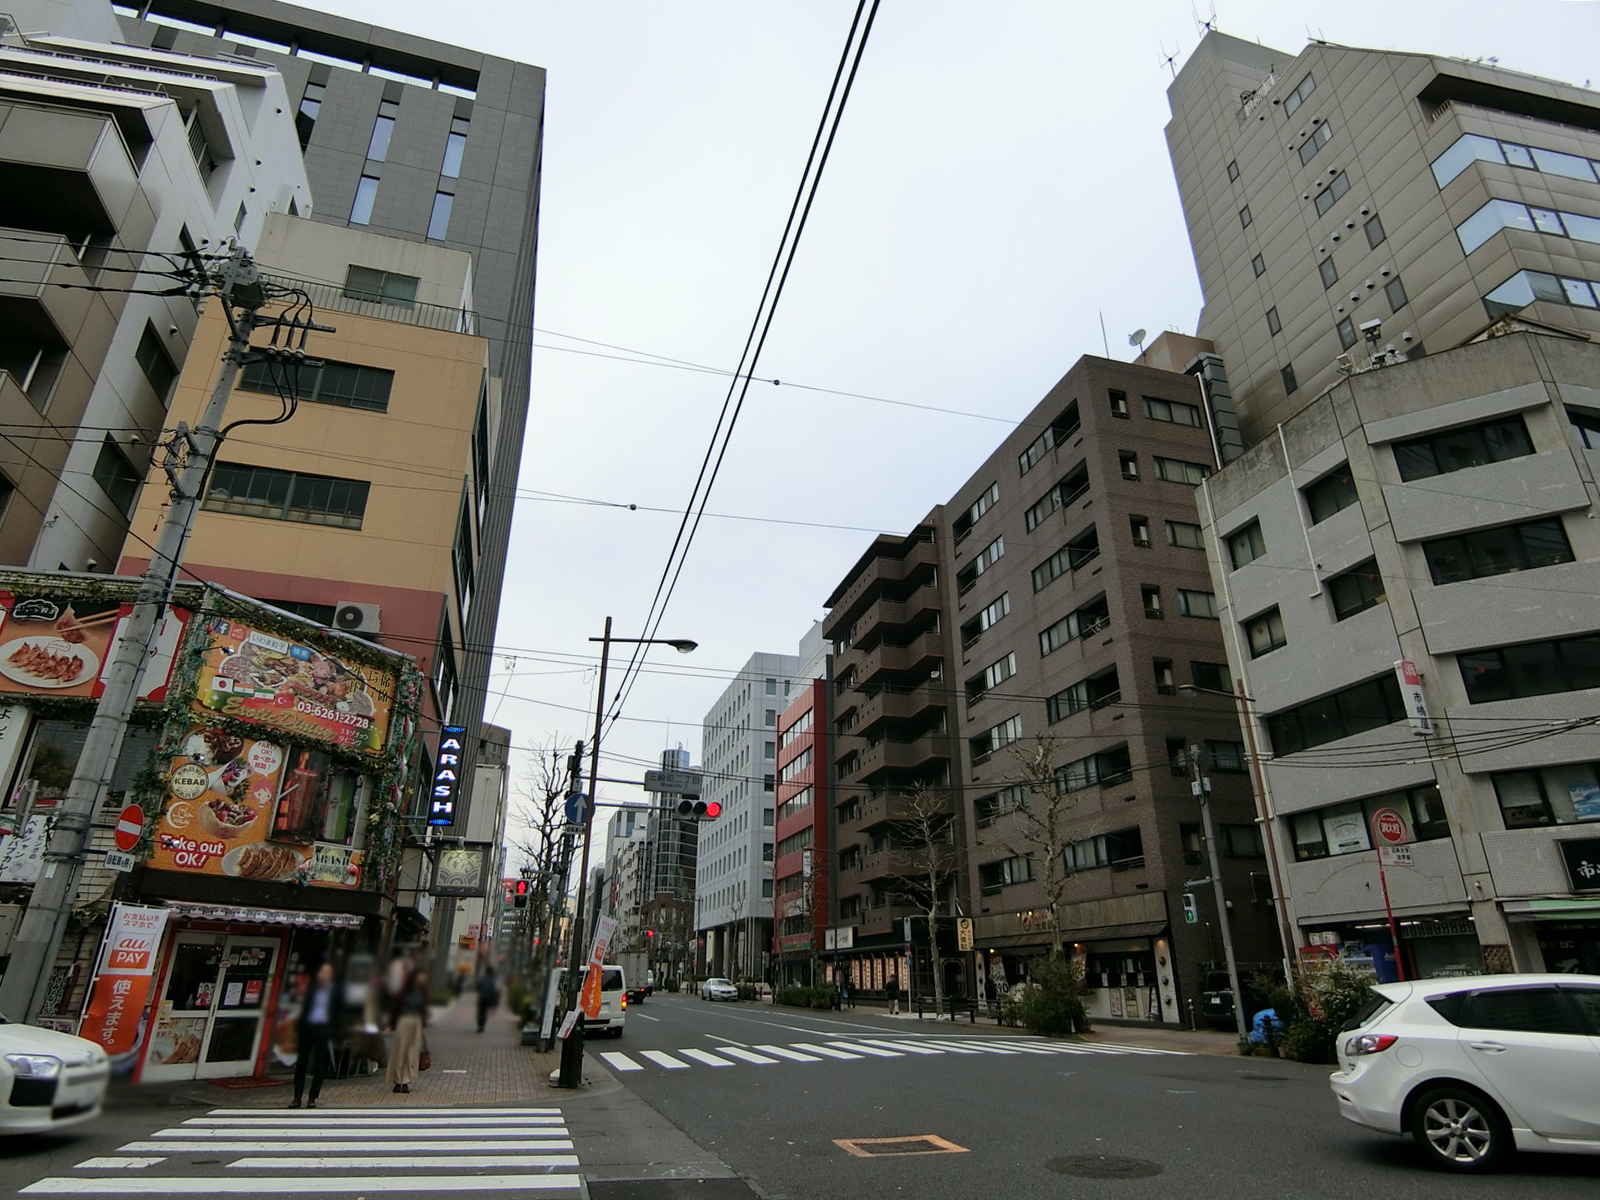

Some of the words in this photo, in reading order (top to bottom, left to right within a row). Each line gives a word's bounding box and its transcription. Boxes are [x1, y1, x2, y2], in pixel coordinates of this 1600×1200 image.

[297, 701, 370, 729] 03-6261-2728
[174, 777, 206, 786] KEBAB
[432, 738, 461, 813] ARASH
[200, 842, 224, 855] out
[175, 851, 207, 866] OK!
[122, 912, 161, 922] お支払いを
[120, 938, 149, 949] au
[116, 952, 144, 963] PAY
[102, 979, 132, 1045] 使えます。
